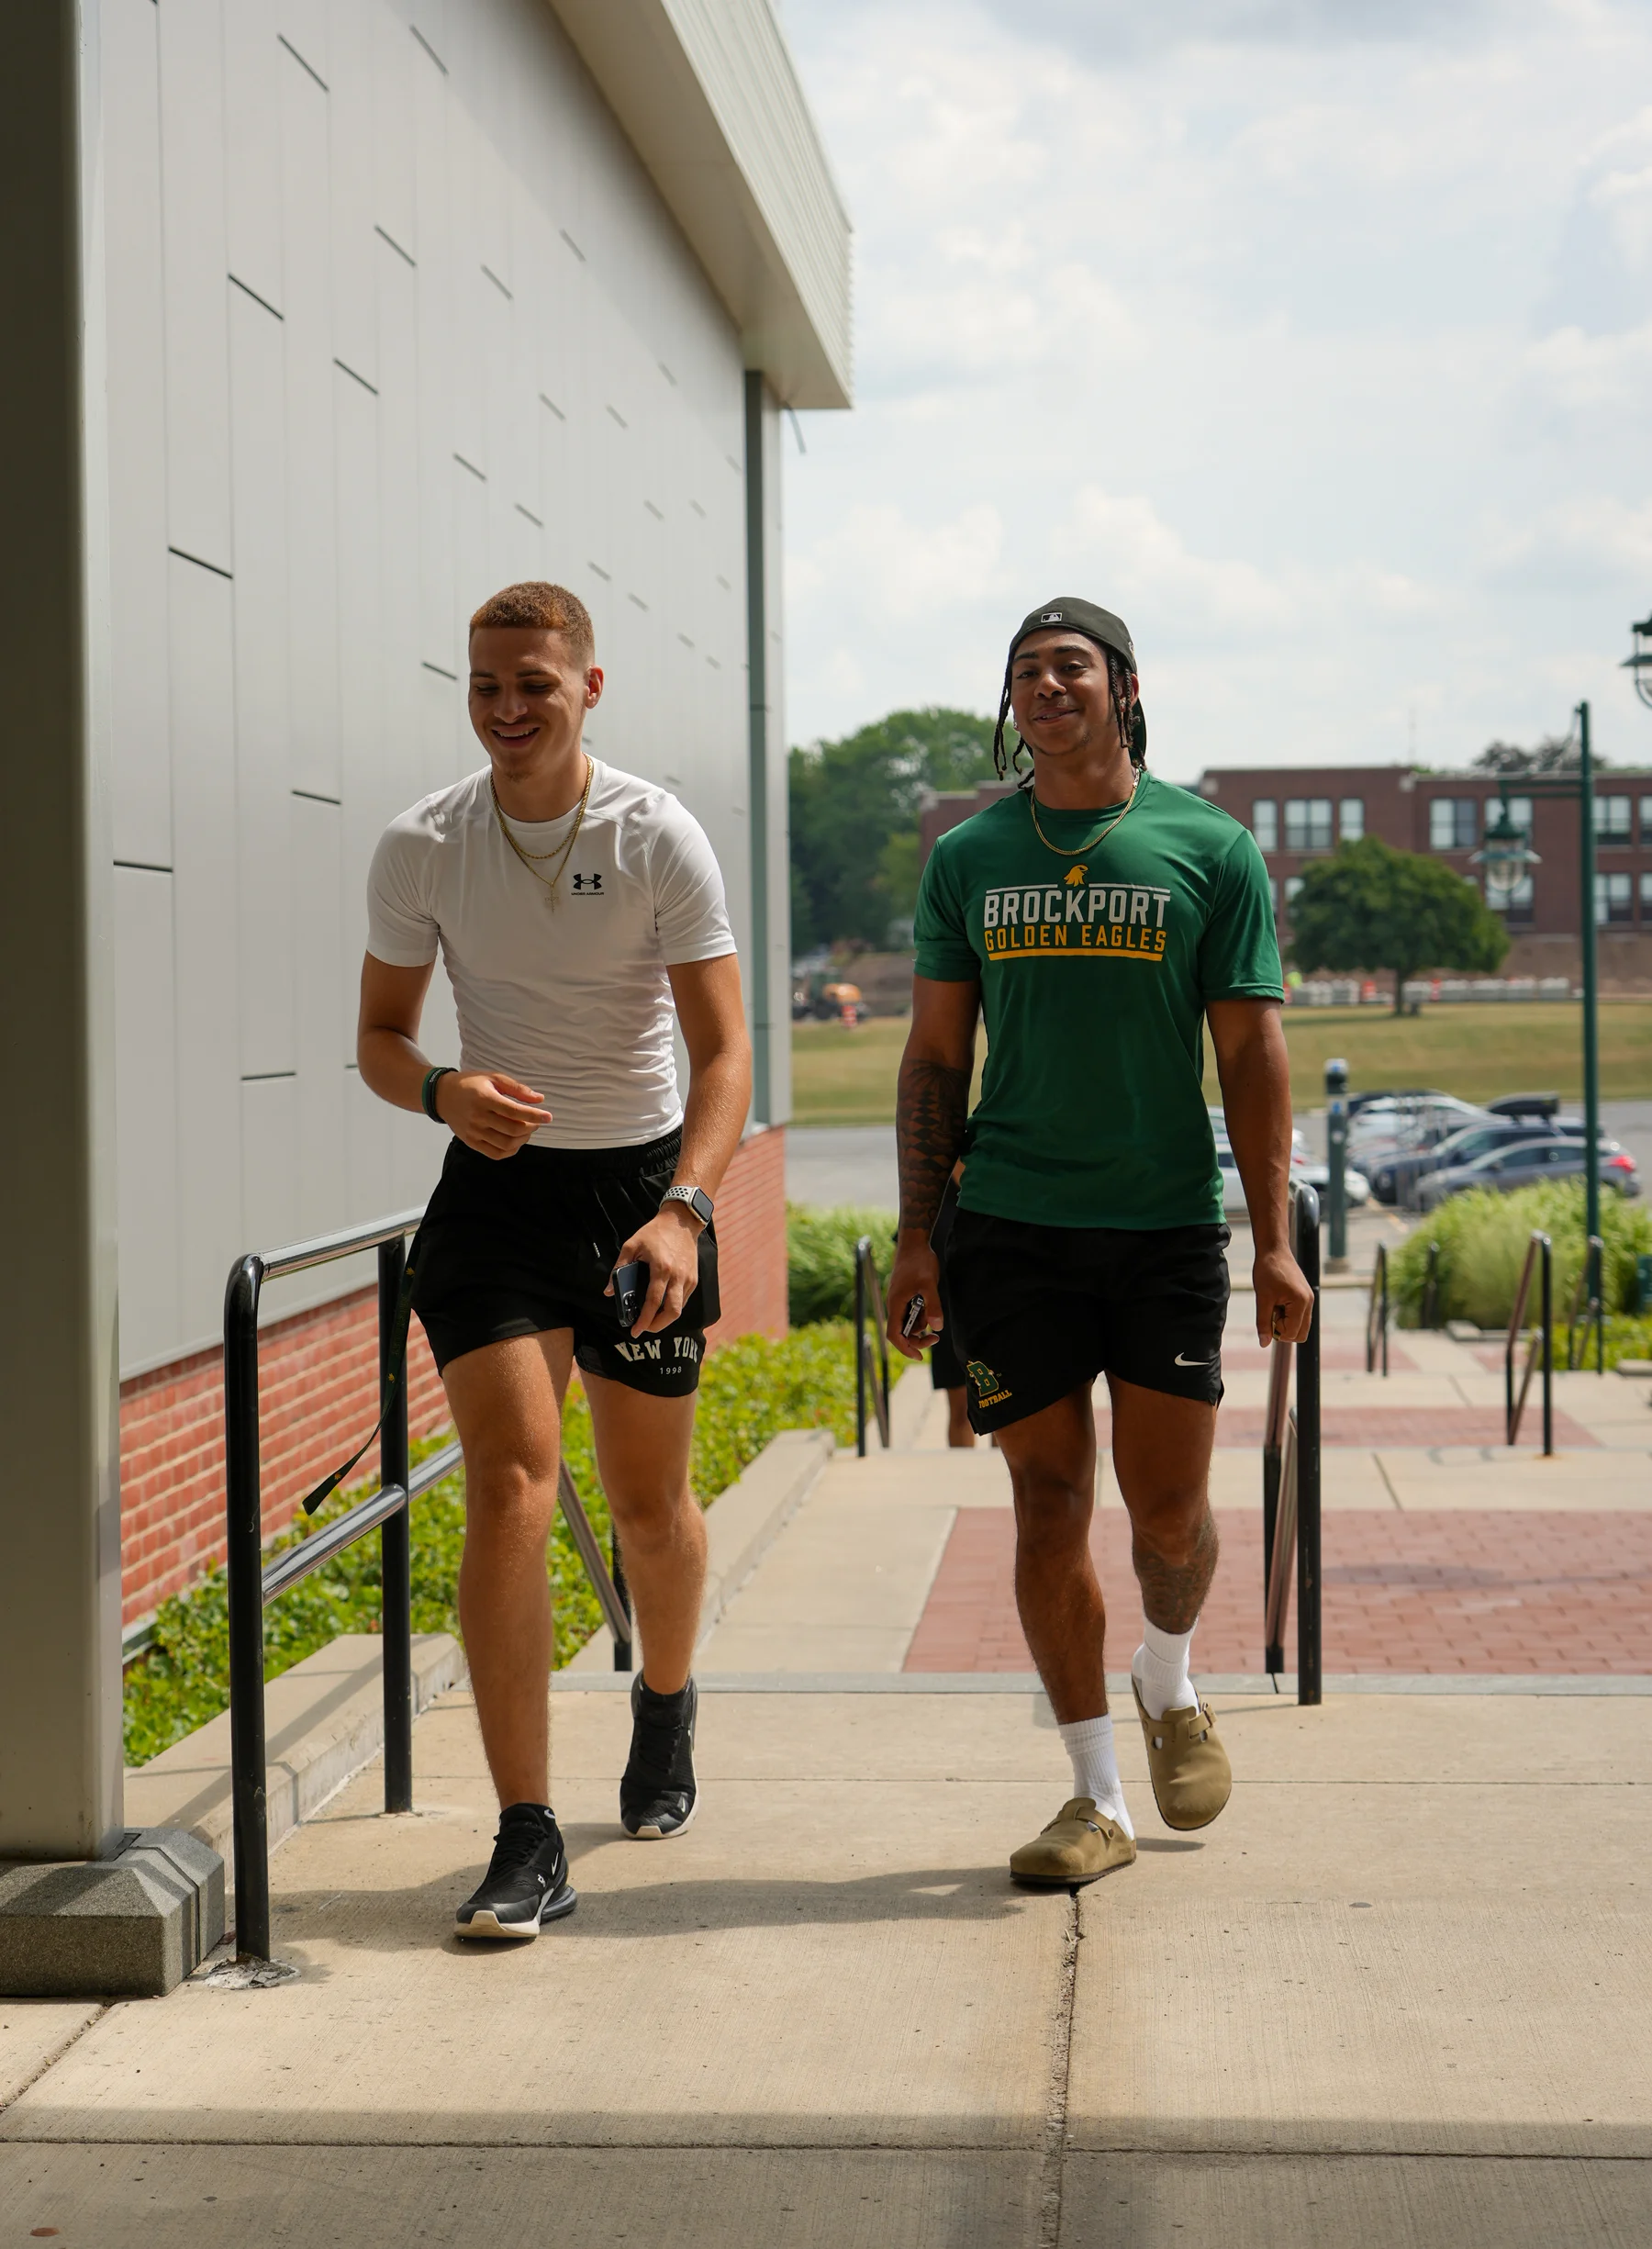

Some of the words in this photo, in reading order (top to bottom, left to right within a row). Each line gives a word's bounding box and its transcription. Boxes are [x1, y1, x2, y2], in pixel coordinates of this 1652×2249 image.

[984, 890, 1171, 929] BROCKPORT
[984, 924, 1067, 952] GOLDEN
[1081, 924, 1167, 952] EAGLES
[614, 1338, 662, 1362] NEW
[674, 1337, 698, 1363] YORK
[659, 1366, 682, 1375] 1998
[978, 1389, 1013, 1409] FOOTBALL
